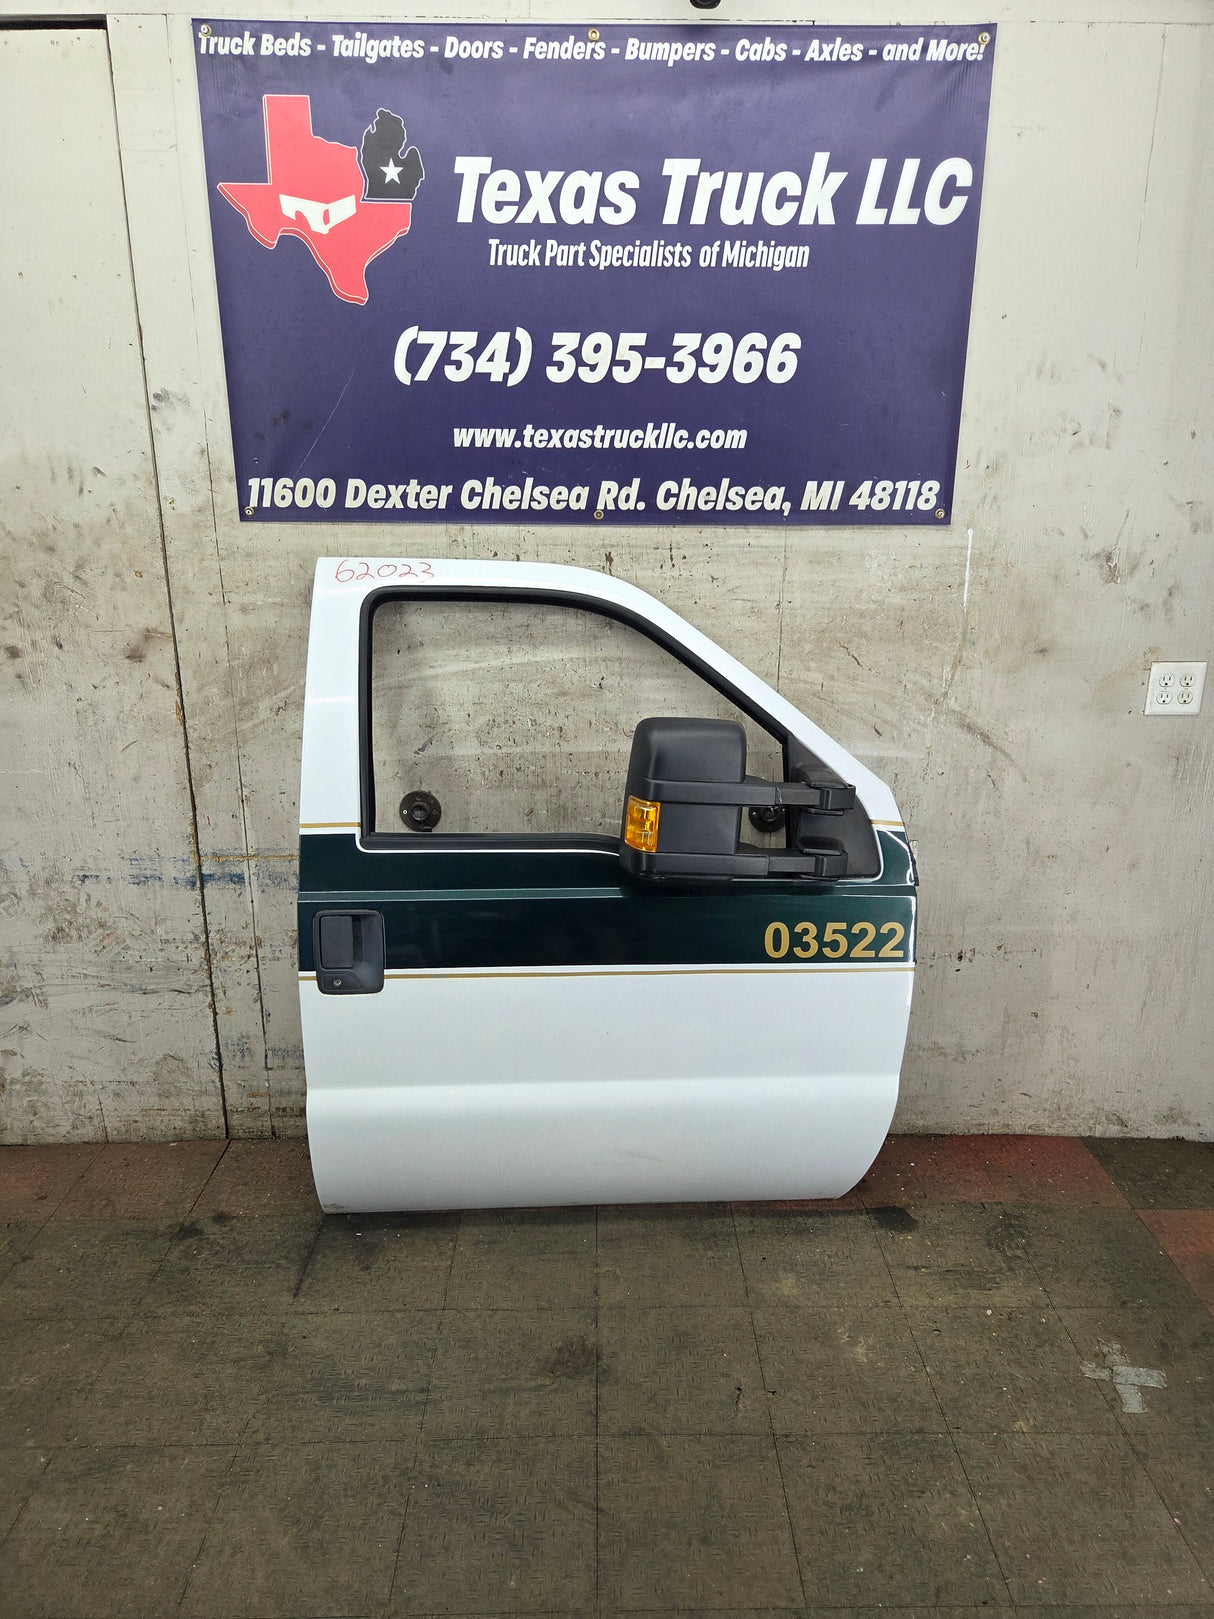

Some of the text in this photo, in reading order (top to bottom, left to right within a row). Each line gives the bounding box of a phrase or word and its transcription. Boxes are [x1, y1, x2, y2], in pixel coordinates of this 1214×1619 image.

[198, 32, 257, 56] Truck
[259, 32, 312, 57] Beds
[331, 32, 426, 64] Tailgates
[444, 36, 504, 60] Doors
[522, 36, 606, 60] Fenders
[624, 37, 716, 67] Bumpers
[734, 36, 787, 62] Cabs
[804, 38, 864, 62] Axles
[881, 38, 921, 62] and
[925, 38, 986, 62] More!
[454, 151, 974, 226] Texas Truck LLC
[488, 239, 810, 272] Truck Part Specialists of Michigan
[393, 325, 801, 387] (734) 395-3966
[453, 423, 748, 449] www.texastruckllc.com
[247, 476, 941, 517] 11600 Dexter Chelsea Rd. Chelsea, MI 48118
[334, 559, 435, 583] 62023
[764, 921, 904, 959] 03522
